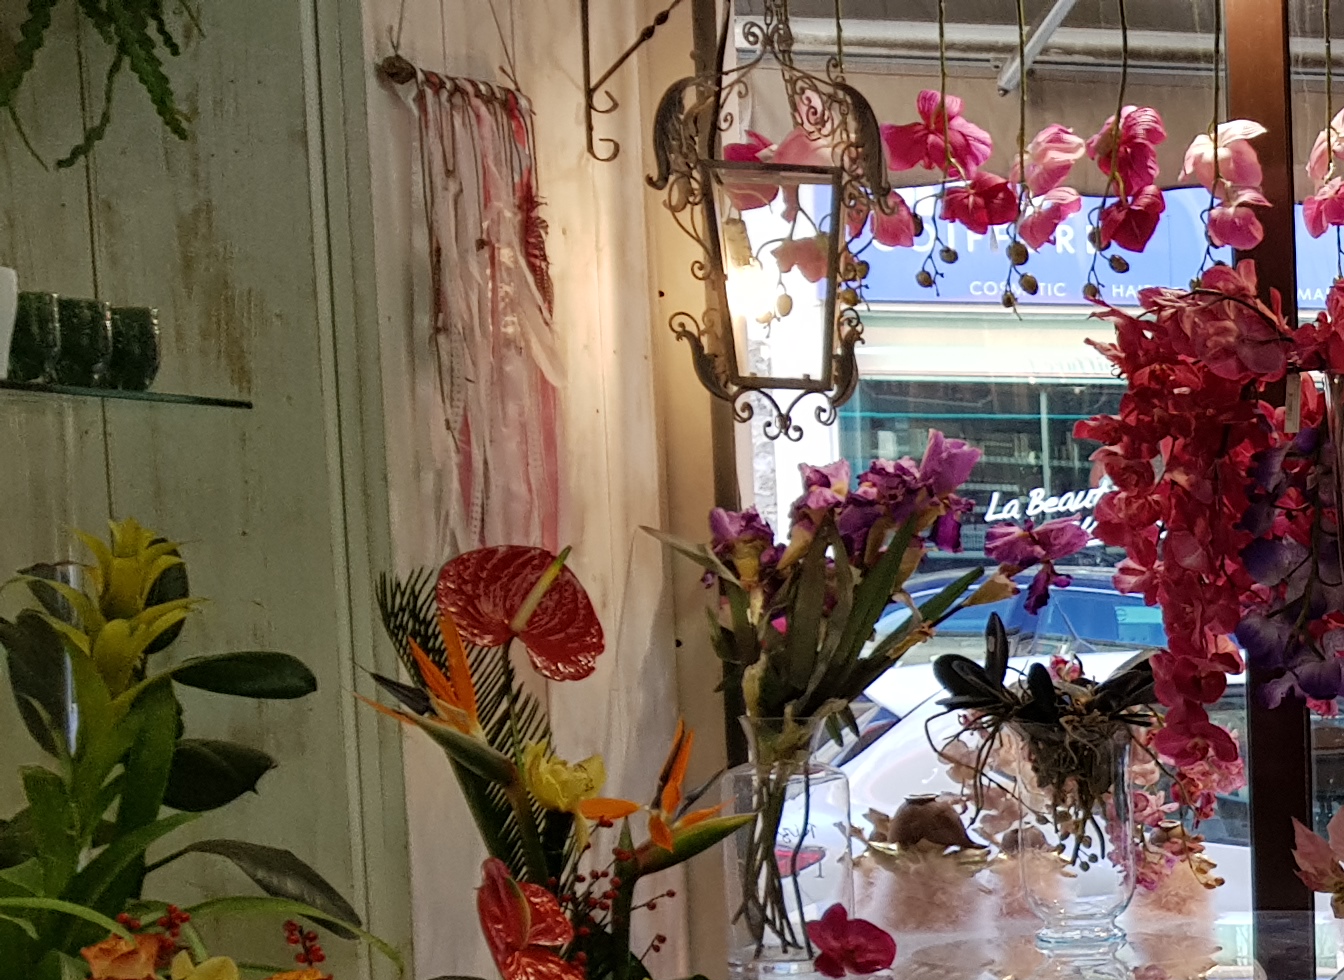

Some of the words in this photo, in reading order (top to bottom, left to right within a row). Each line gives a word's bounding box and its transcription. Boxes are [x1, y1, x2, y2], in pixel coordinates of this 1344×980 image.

[969, 280, 1067, 297] COSMTIC
[984, 490, 1022, 523] La
[1025, 474, 1120, 517] Beaut
